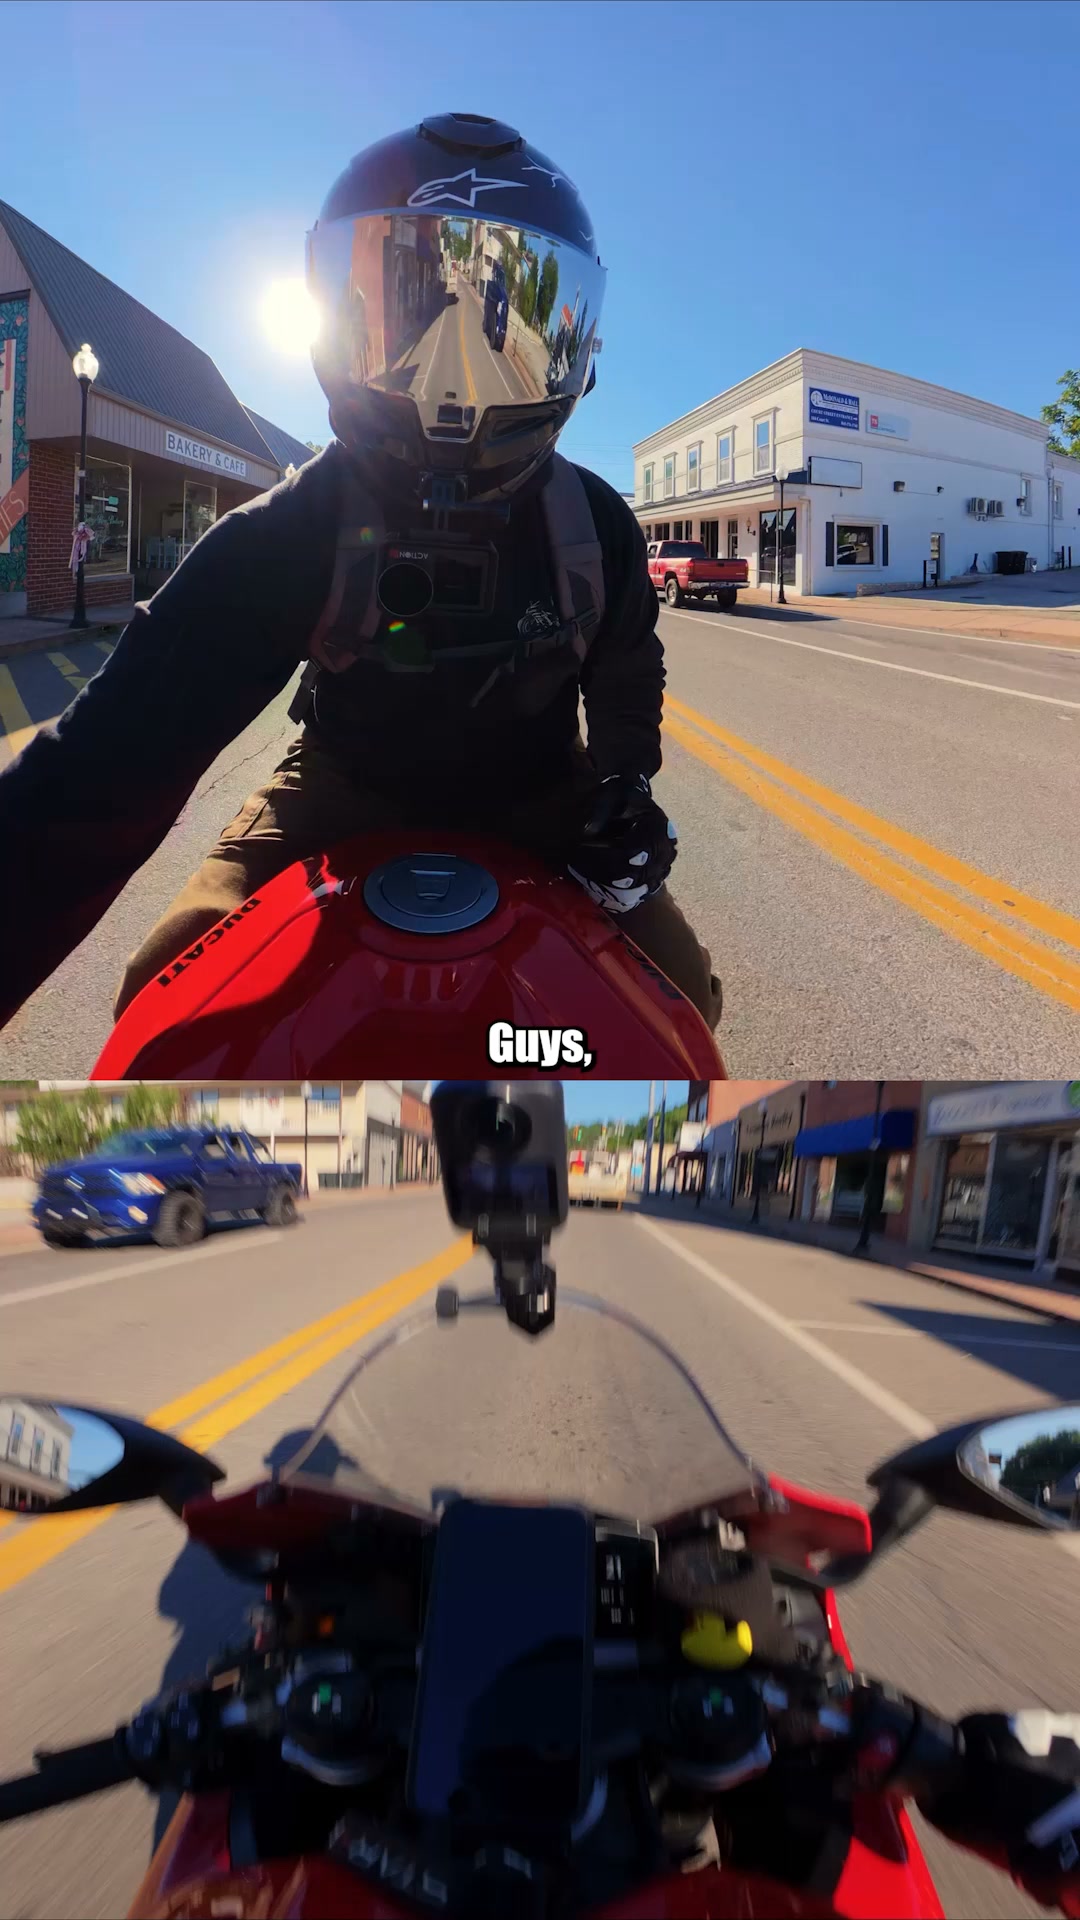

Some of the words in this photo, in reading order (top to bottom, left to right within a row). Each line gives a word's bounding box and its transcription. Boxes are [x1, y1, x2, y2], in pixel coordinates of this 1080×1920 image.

[168, 434, 212, 463] BAKERY
[215, 453, 222, 467] &
[223, 456, 245, 475] CAFE
[399, 551, 429, 560] ACTION
[157, 898, 262, 987] DUCATI
